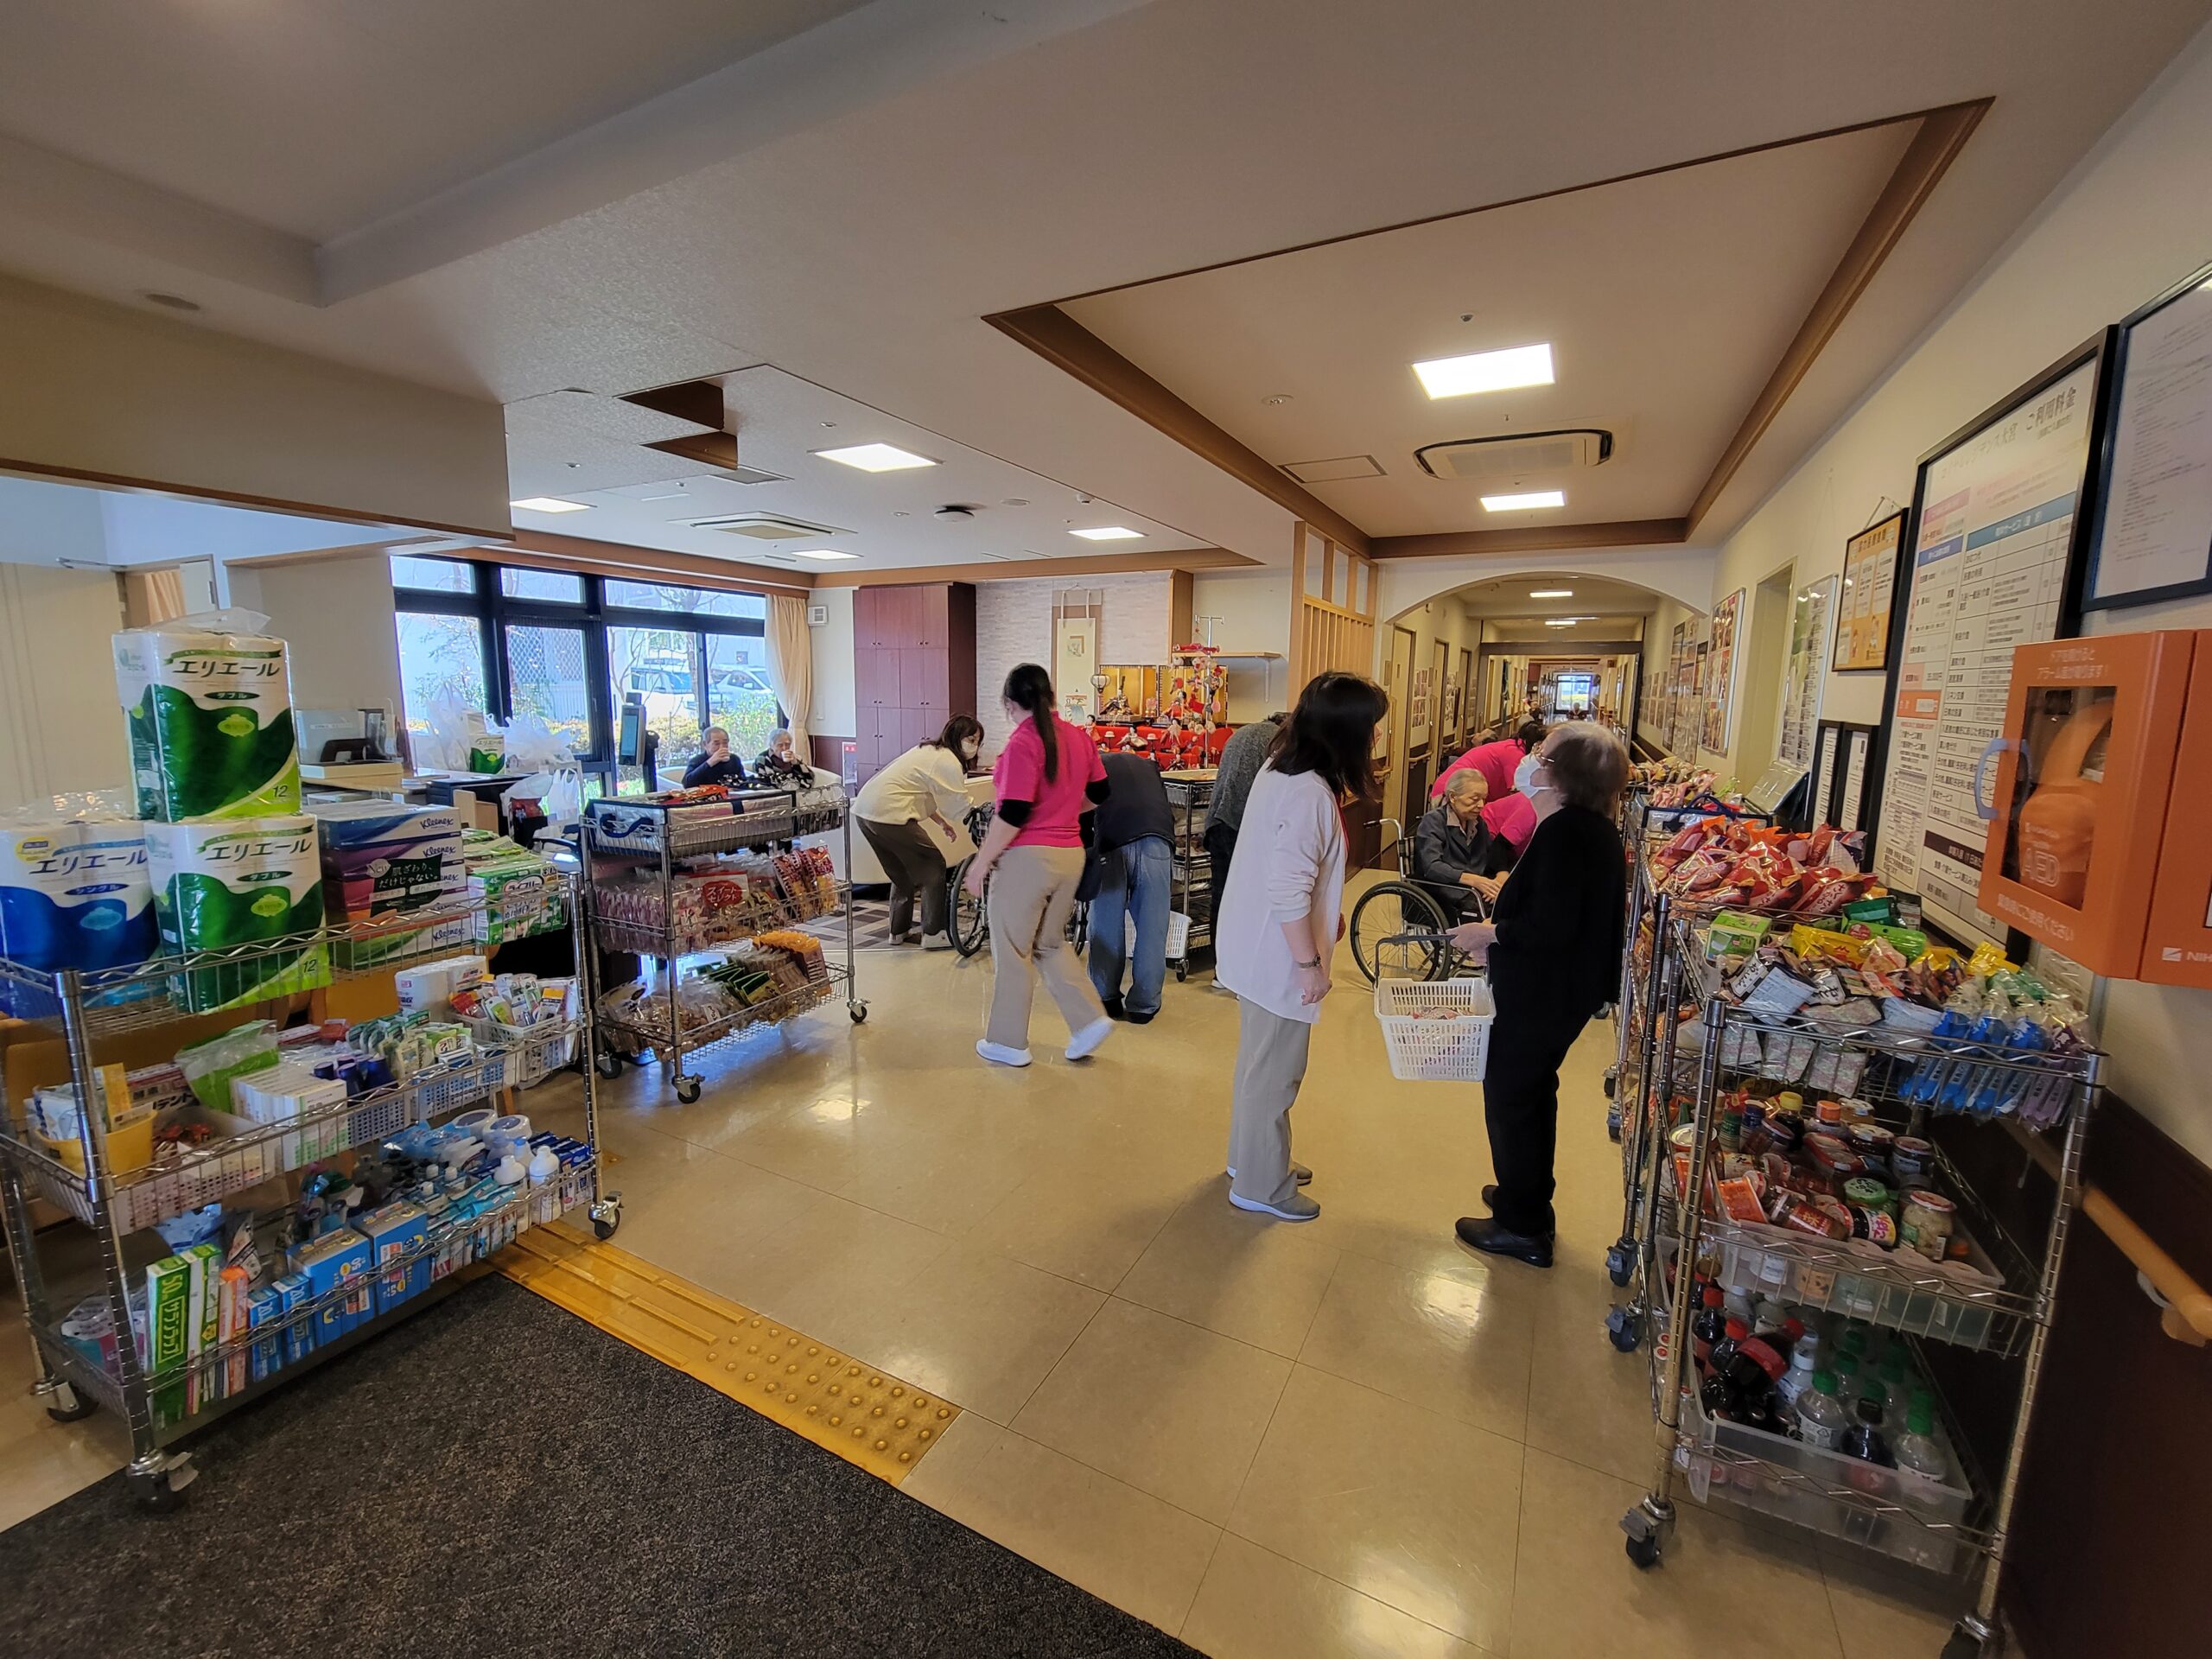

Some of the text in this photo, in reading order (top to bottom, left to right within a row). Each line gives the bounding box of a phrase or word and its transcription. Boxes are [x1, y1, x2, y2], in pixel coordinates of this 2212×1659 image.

[2025, 386, 2076, 431] ご利用料金
[172, 660, 280, 678] エリエール
[272, 785, 289, 798] 12
[420, 817, 454, 830] Kleenex
[205, 837, 313, 862] エリエール
[423, 845, 456, 858] Kleenex
[29, 849, 148, 876] エリエール
[391, 862, 433, 876] 肌ざわり、
[2021, 847, 2061, 887] AED
[250, 871, 282, 880] ダブル
[378, 873, 438, 888] だけじゃない。
[75, 884, 121, 895] シングル
[707, 886, 737, 896] スイート
[707, 893, 737, 903] セレクト
[432, 926, 465, 942] Kleenex
[302, 958, 317, 974] 12
[162, 1300, 181, 1355] サランラップ
